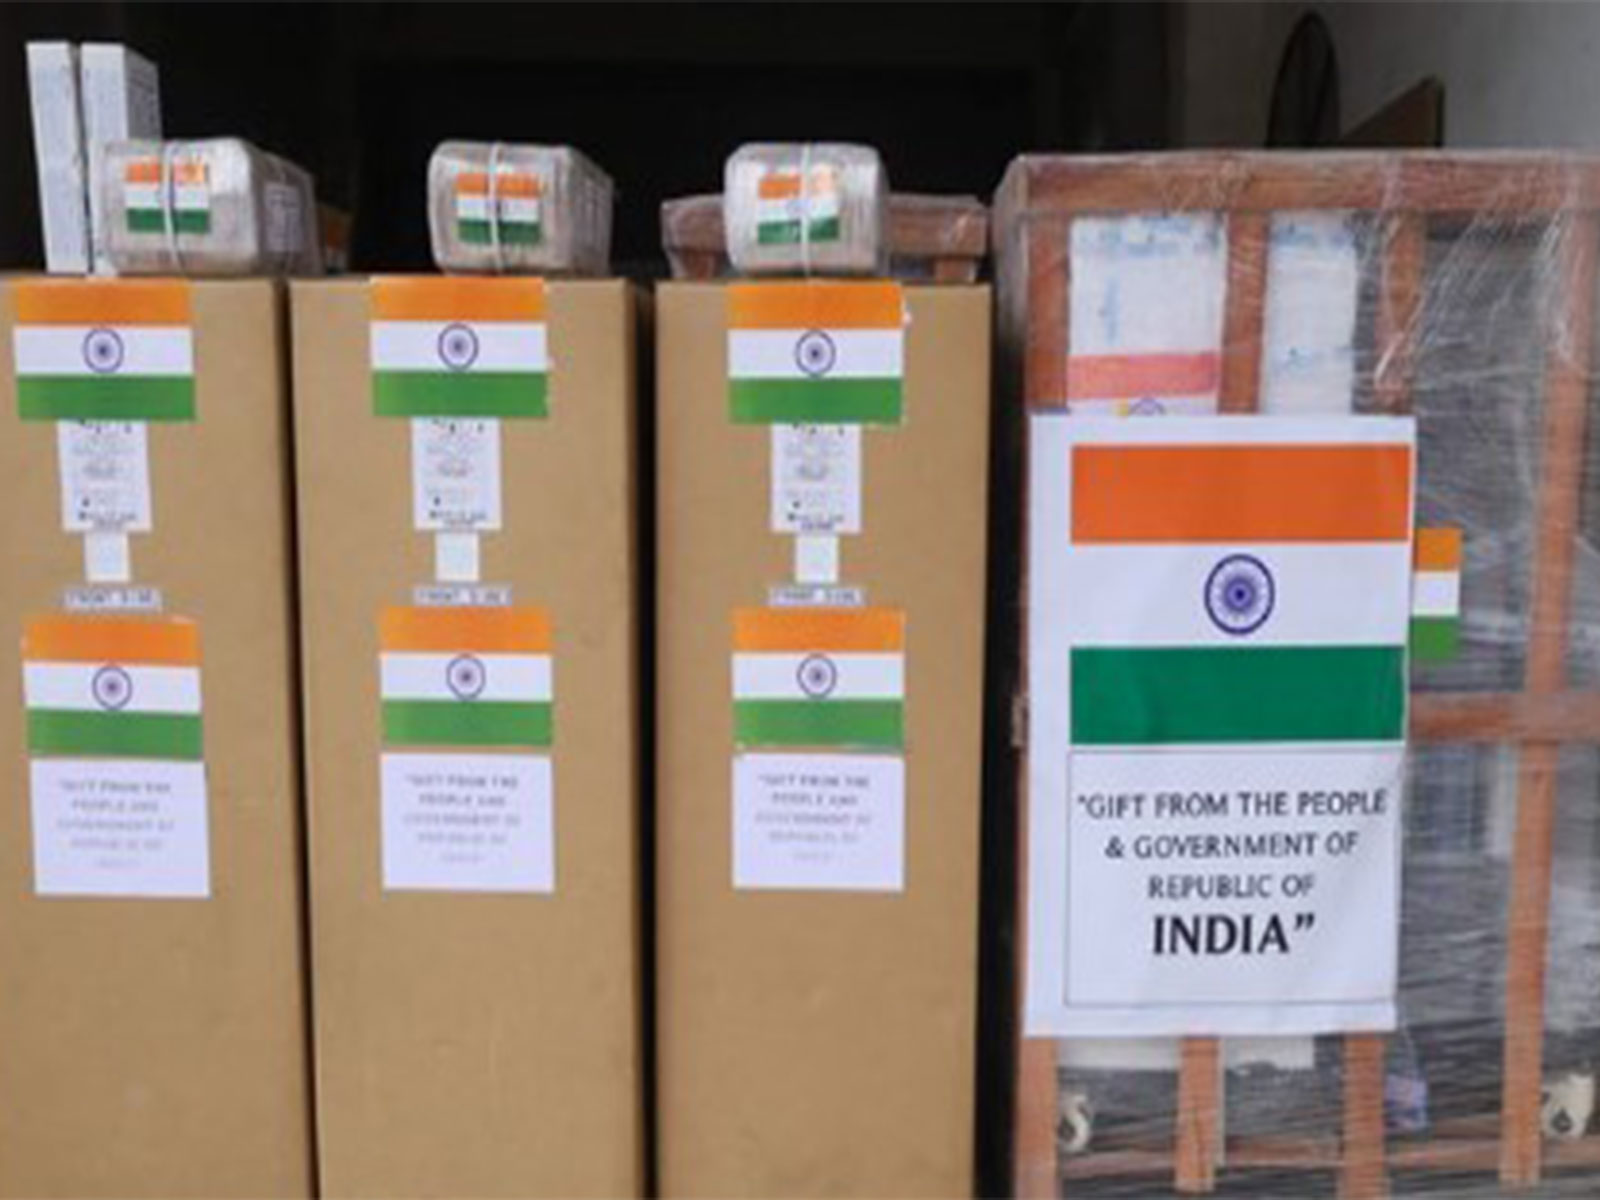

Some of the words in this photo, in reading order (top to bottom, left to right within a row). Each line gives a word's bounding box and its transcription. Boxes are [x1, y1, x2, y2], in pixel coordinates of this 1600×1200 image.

[1154, 792, 1229, 819] FROM
[1237, 791, 1289, 817] THE
[1296, 788, 1387, 817] PEOPLE
[1104, 835, 1125, 859] &
[1133, 832, 1319, 859] GOVERNMENT
[1325, 830, 1359, 856] OF
[1148, 874, 1272, 899] REPUBLIC
[1281, 873, 1315, 897] OF
